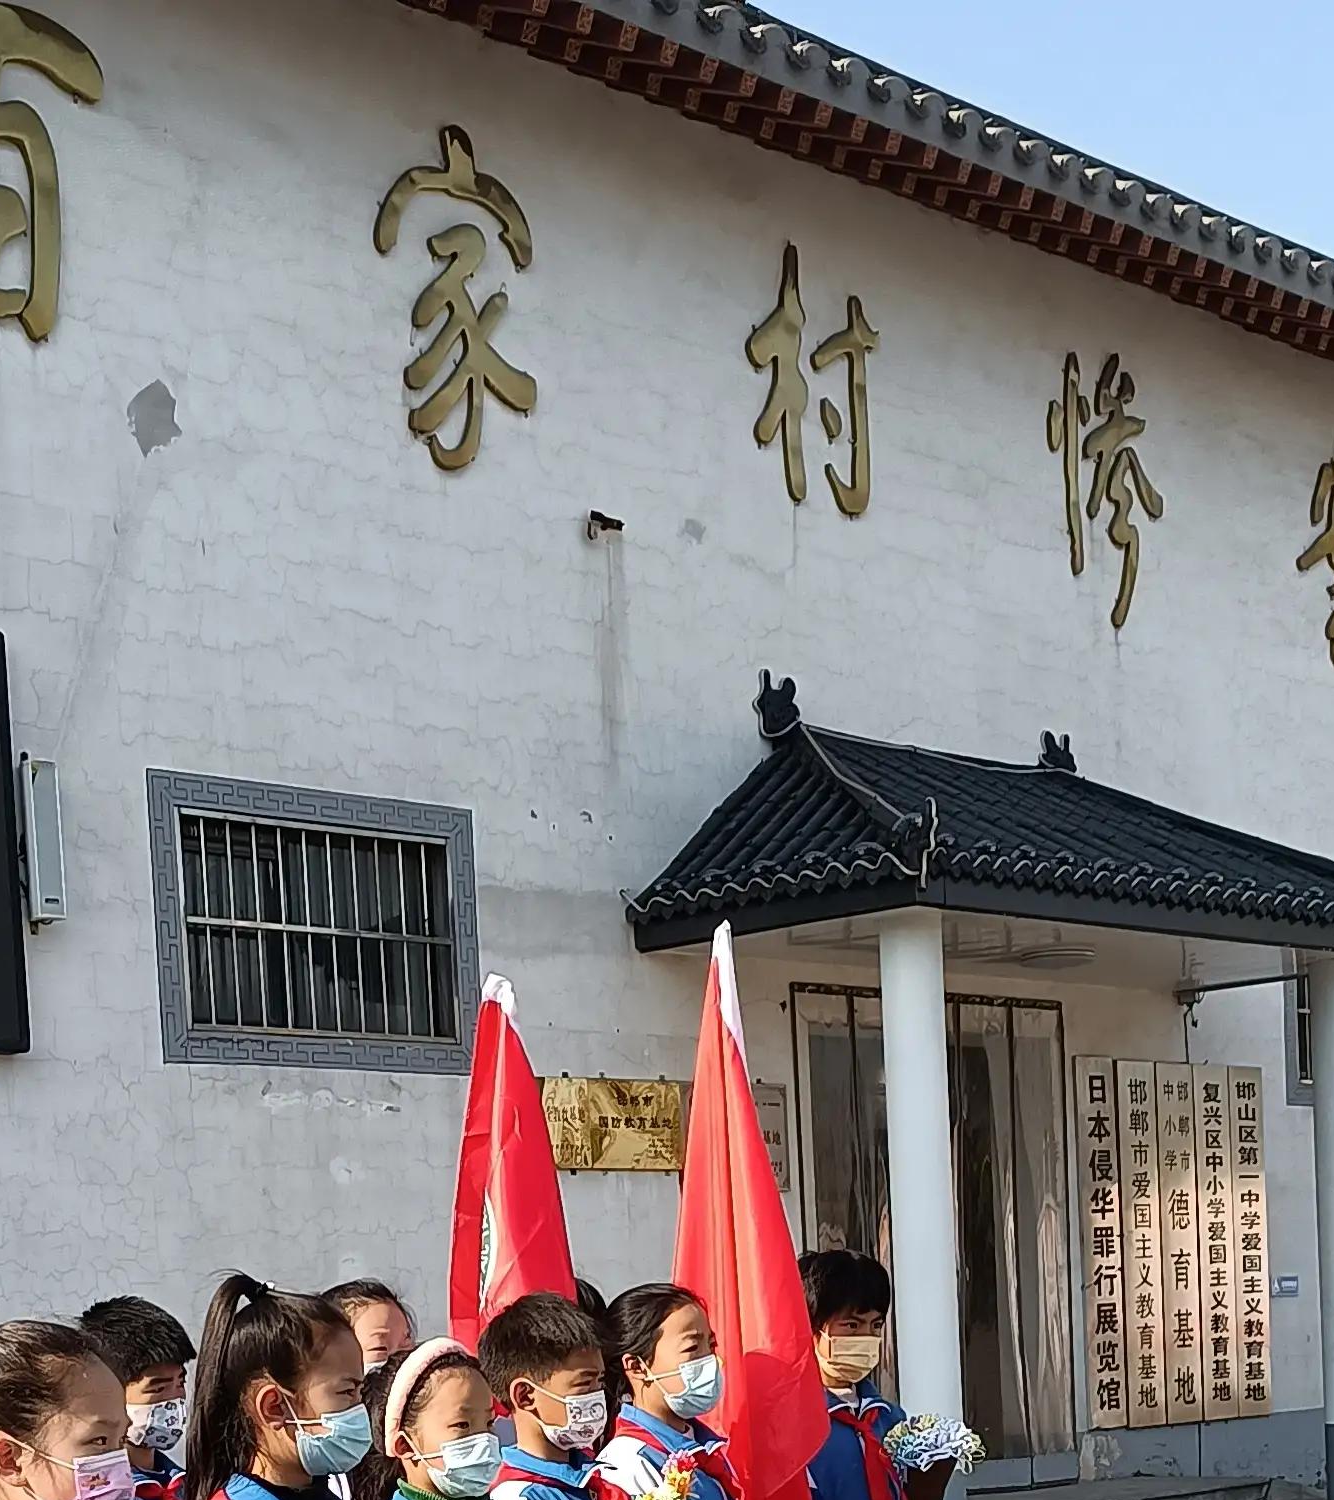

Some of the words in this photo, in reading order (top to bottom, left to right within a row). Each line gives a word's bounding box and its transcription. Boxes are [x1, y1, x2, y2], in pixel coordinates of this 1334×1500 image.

[1088, 1074, 1122, 1411] 日本侵华罪行展览馆
[1127, 1077, 1159, 1409] 邯郸市爱国主义教育基地
[1163, 1080, 1178, 1172] 中小学
[1175, 1080, 1191, 1172] 邯郸市
[1202, 1081, 1233, 1402] 复兴区中小学爱国主义教育基地
[1234, 1080, 1267, 1402] 邯山区第一中学爱国主义教育基地
[1167, 1188, 1197, 1405] 德育基地
